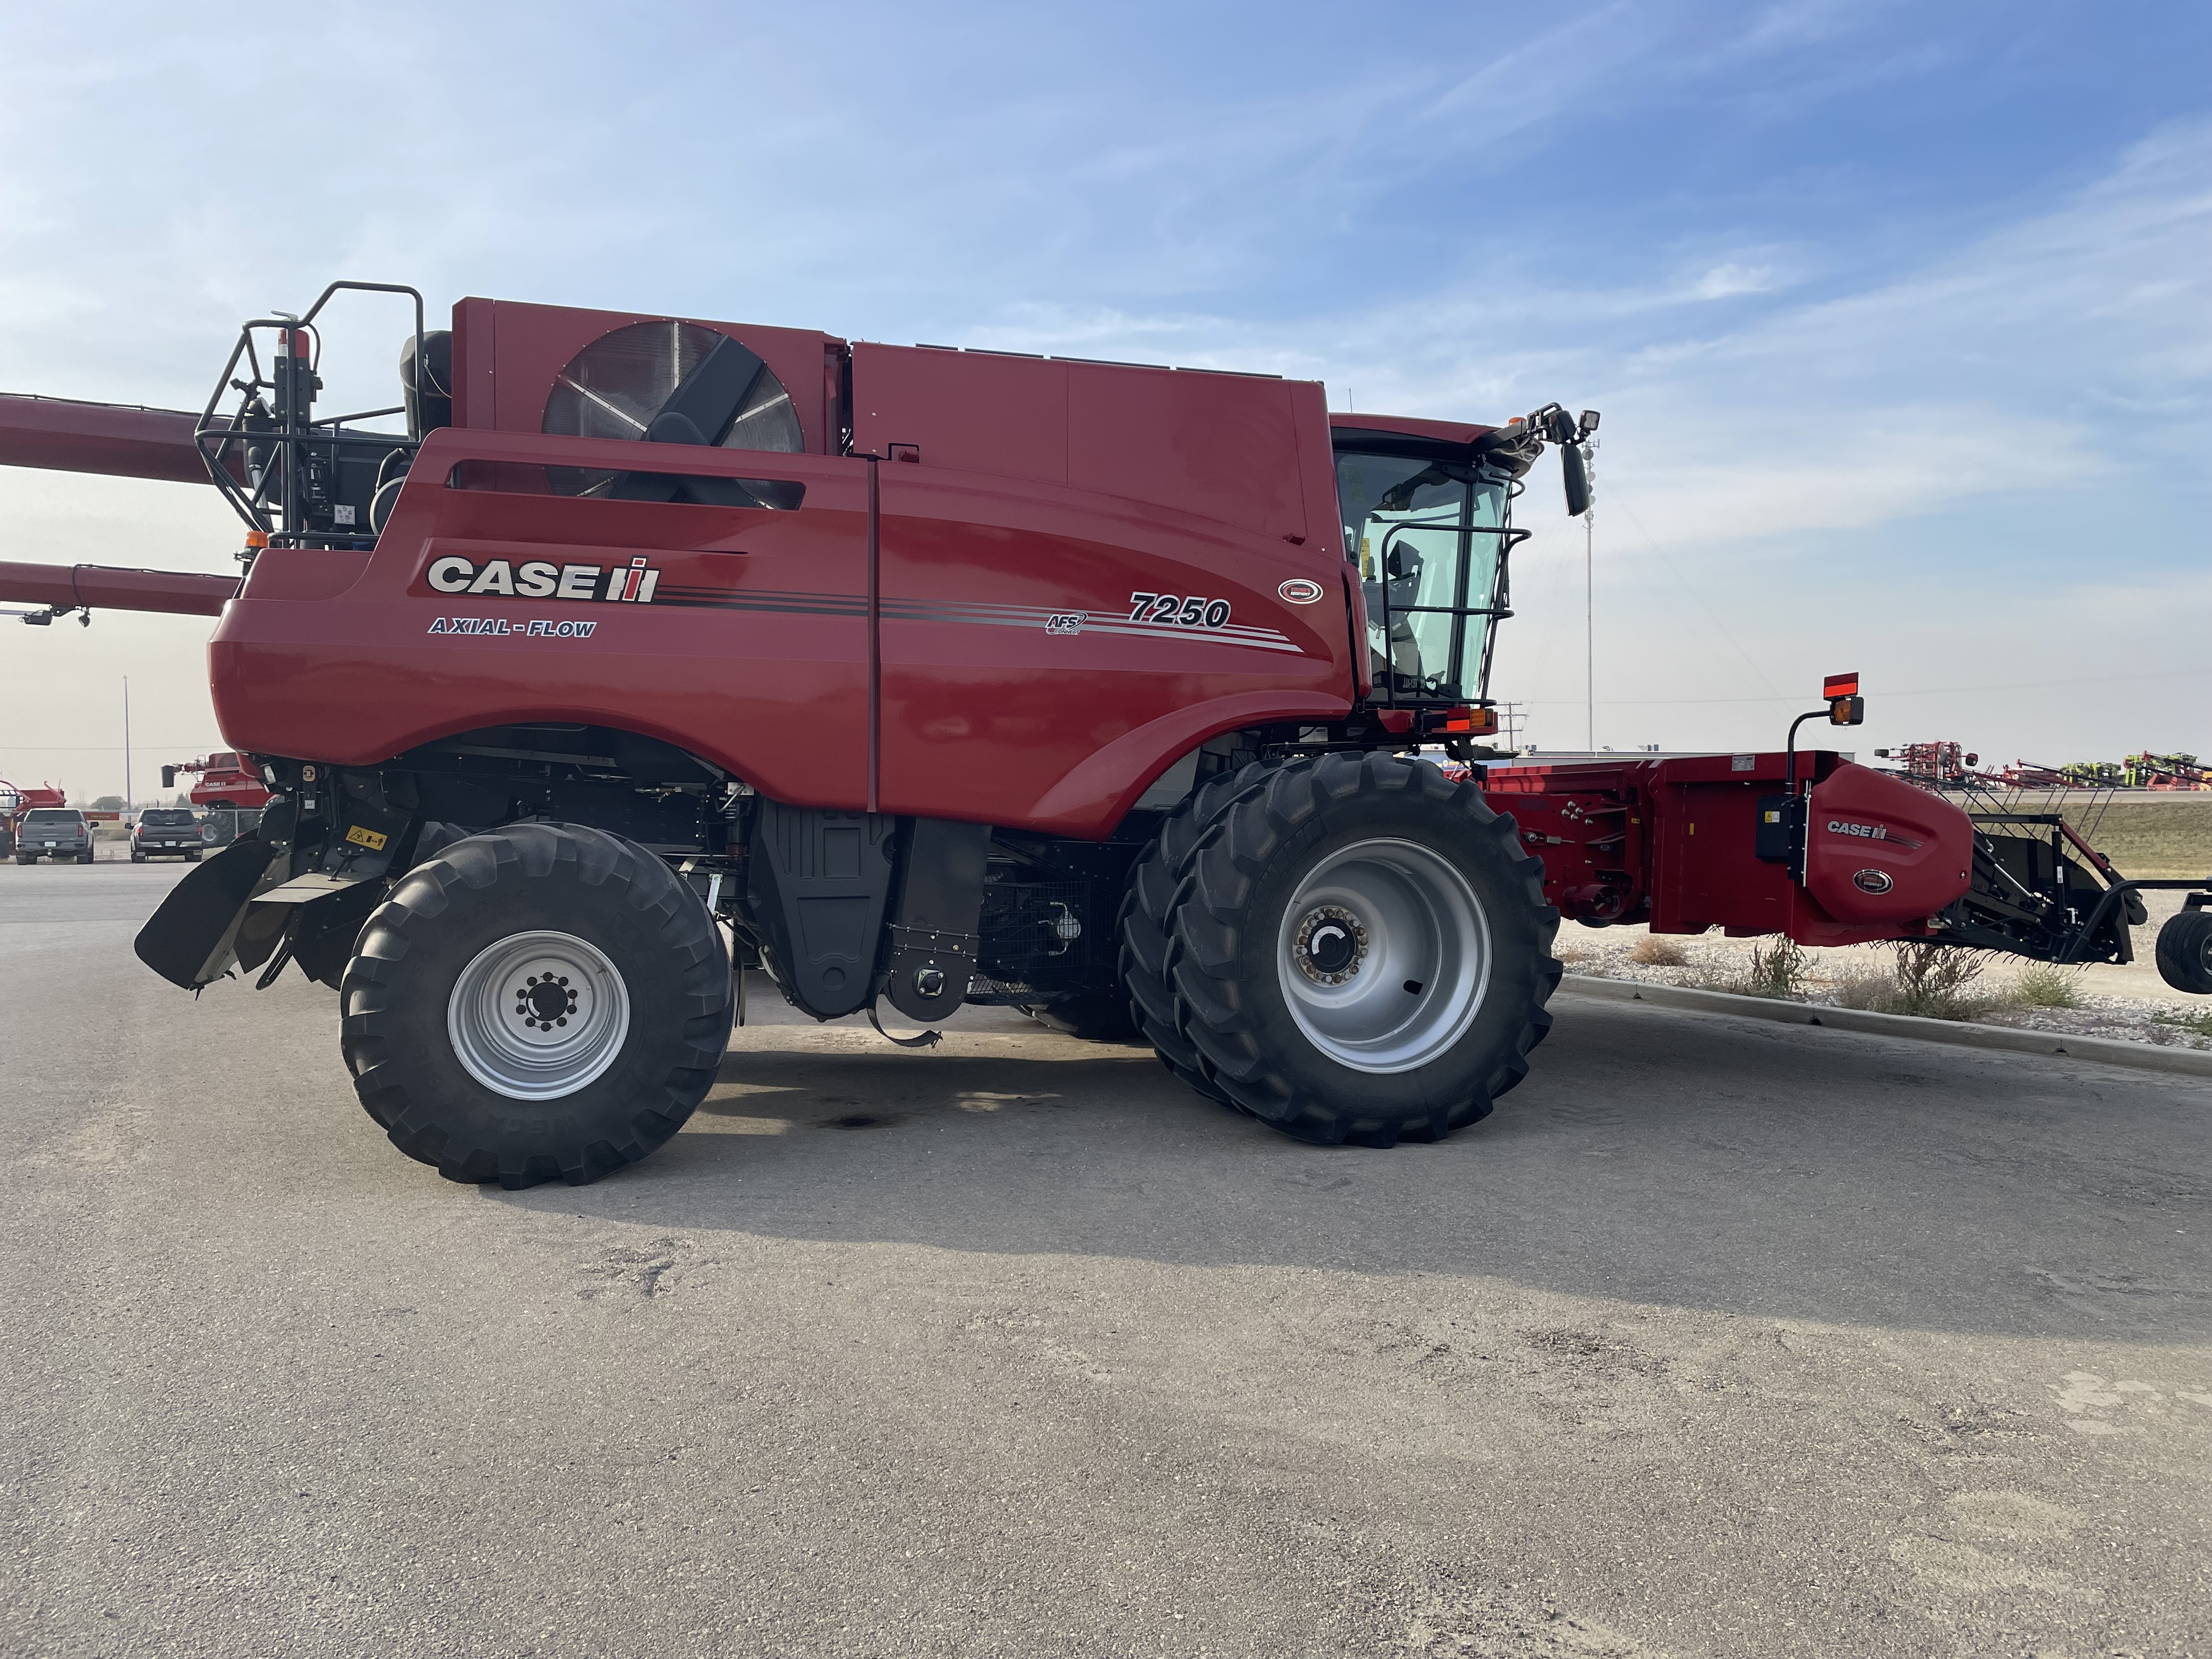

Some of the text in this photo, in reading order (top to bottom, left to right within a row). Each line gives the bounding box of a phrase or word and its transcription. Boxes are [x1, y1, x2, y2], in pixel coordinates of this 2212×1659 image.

[428, 556, 601, 599] CASE
[1128, 591, 1232, 629] 7250
[427, 617, 597, 638] AXIAL-FLOW
[1045, 614, 1080, 629] AFS
[1827, 821, 1871, 837] CASE
